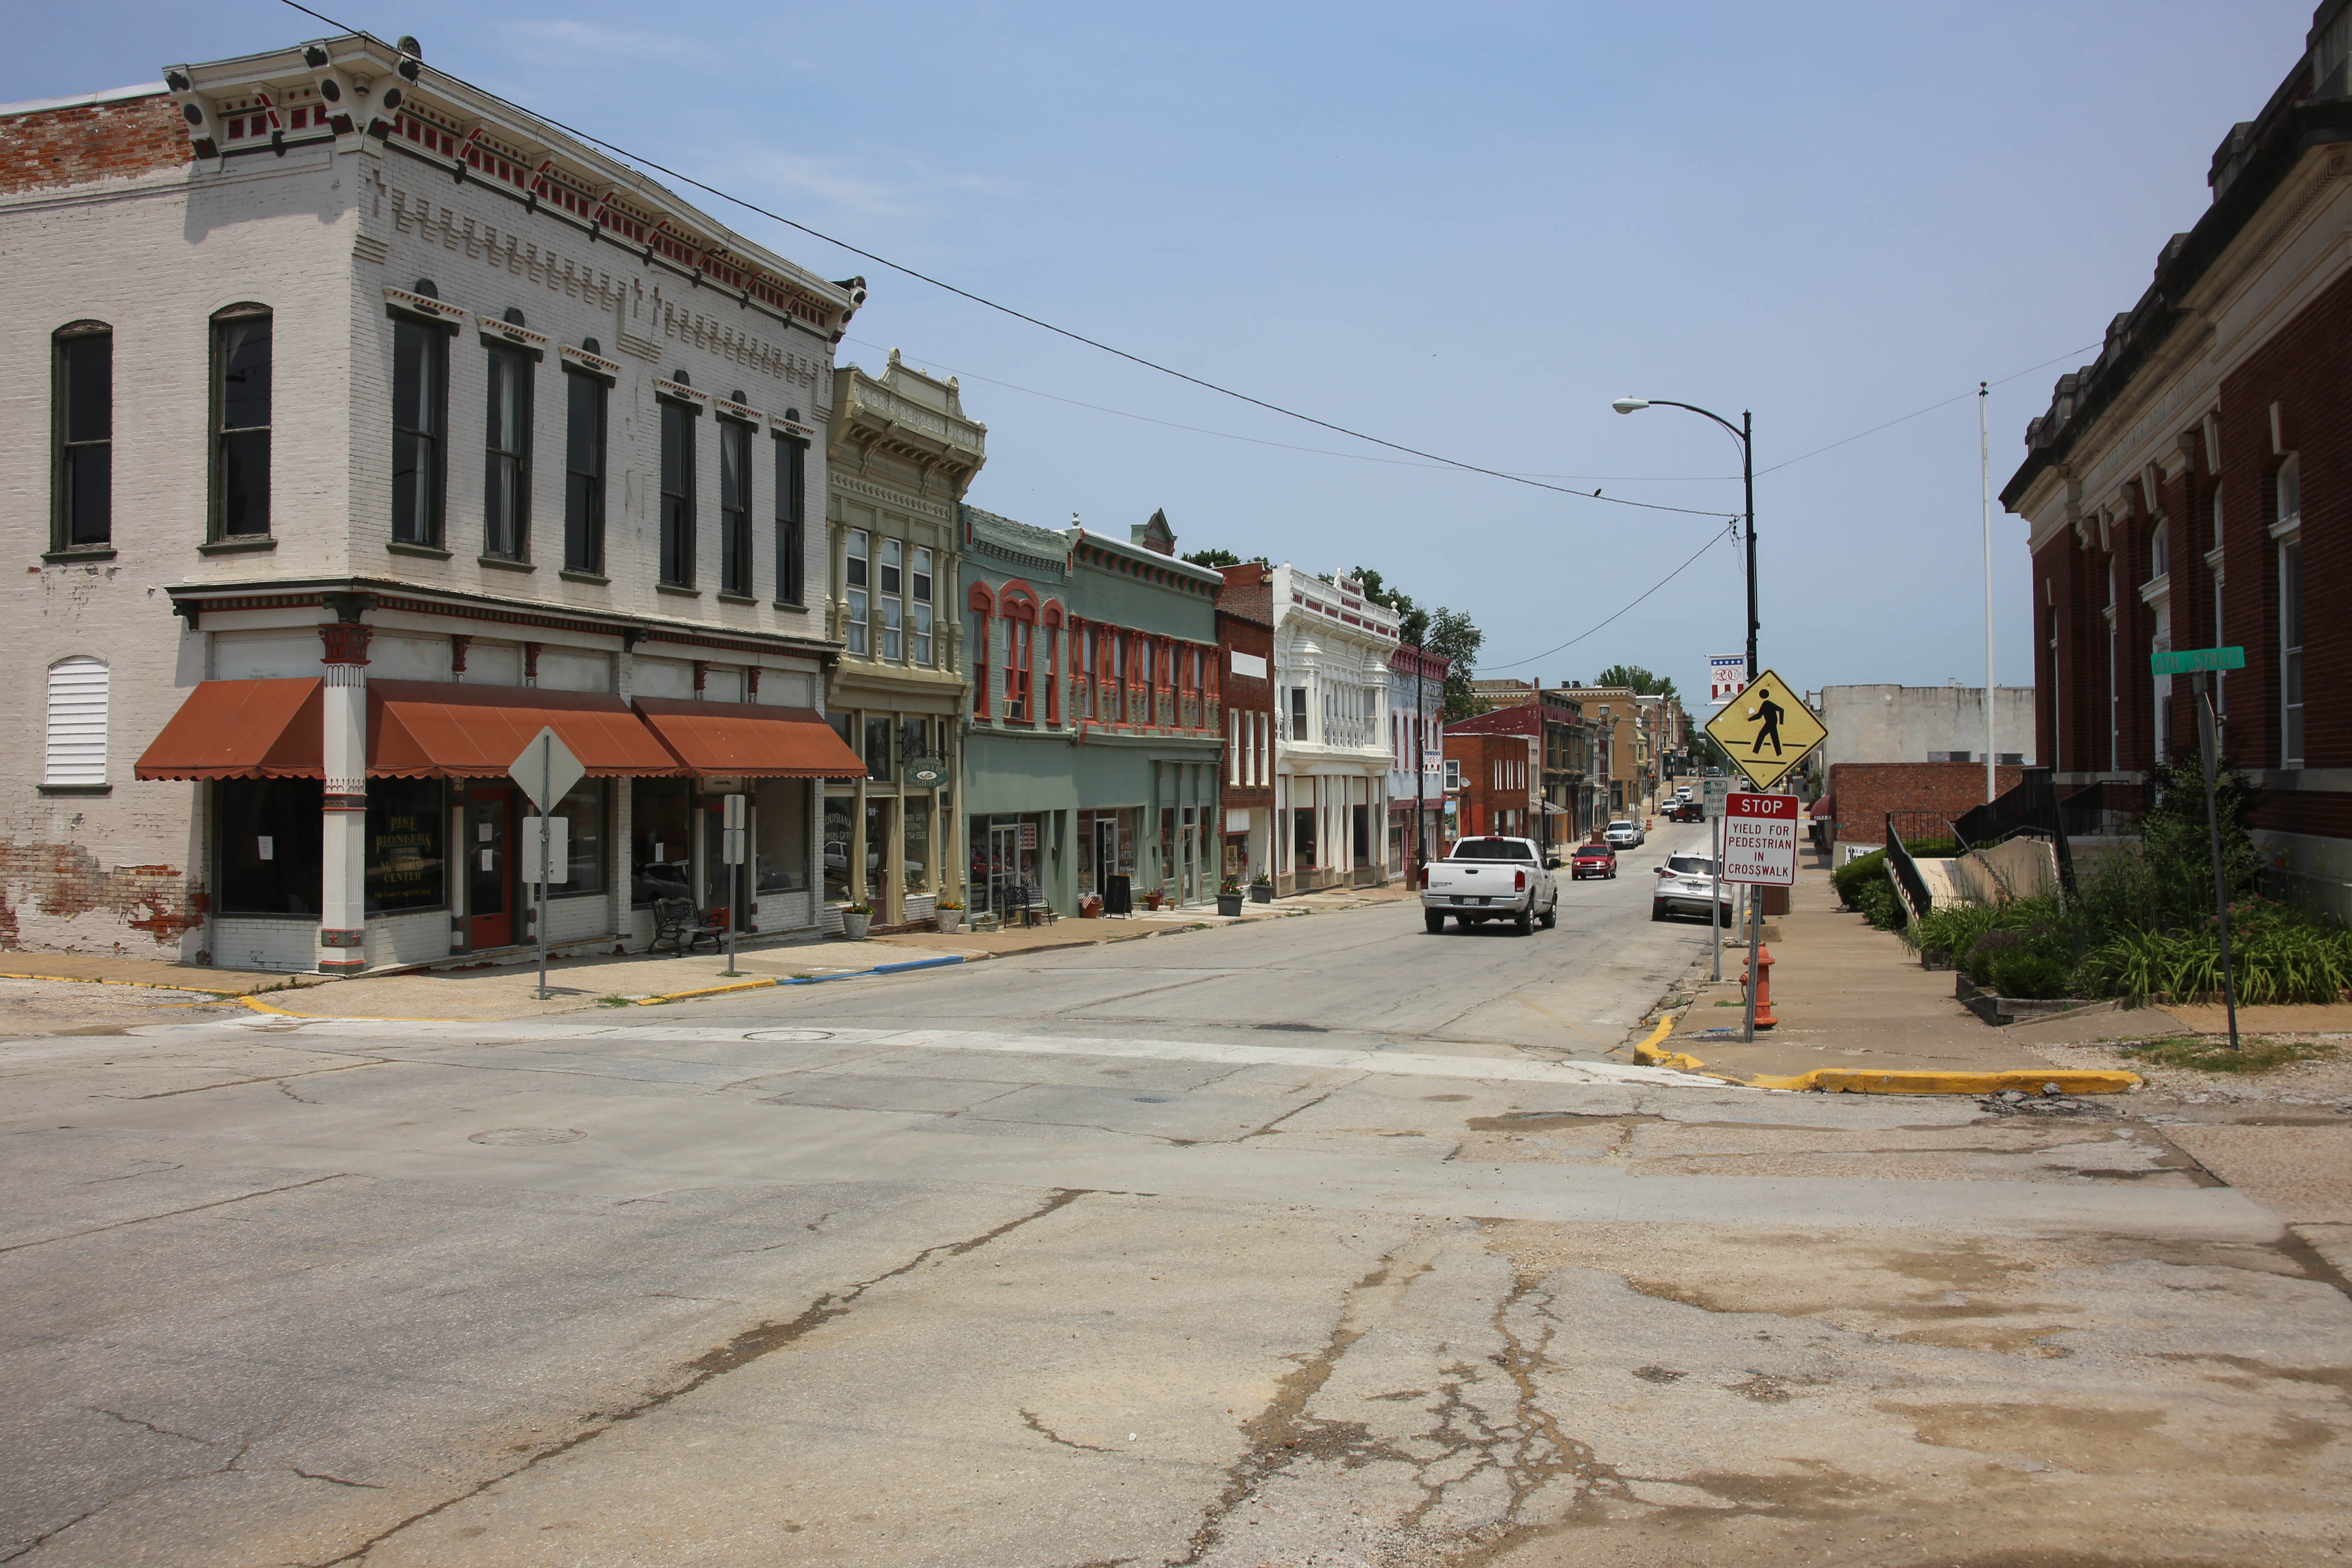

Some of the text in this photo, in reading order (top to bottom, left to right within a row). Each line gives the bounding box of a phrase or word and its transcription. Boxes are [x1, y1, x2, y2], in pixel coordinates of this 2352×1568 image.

[2149, 398, 2165, 431] POST
[2156, 650, 2240, 672] 6TH STREET
[909, 765, 943, 775] FLOWERS
[1742, 799, 1782, 814] STOP
[391, 816, 416, 831] PIKE
[825, 813, 851, 829] OUISIANA
[1733, 823, 1789, 836] YIELD FOR
[376, 833, 431, 853] PIONEERS
[1729, 837, 1791, 849] PEDESTRIAN
[1755, 852, 1764, 861] IN
[384, 871, 421, 882] CENTER
[1728, 864, 1788, 877] CROSSWALK
